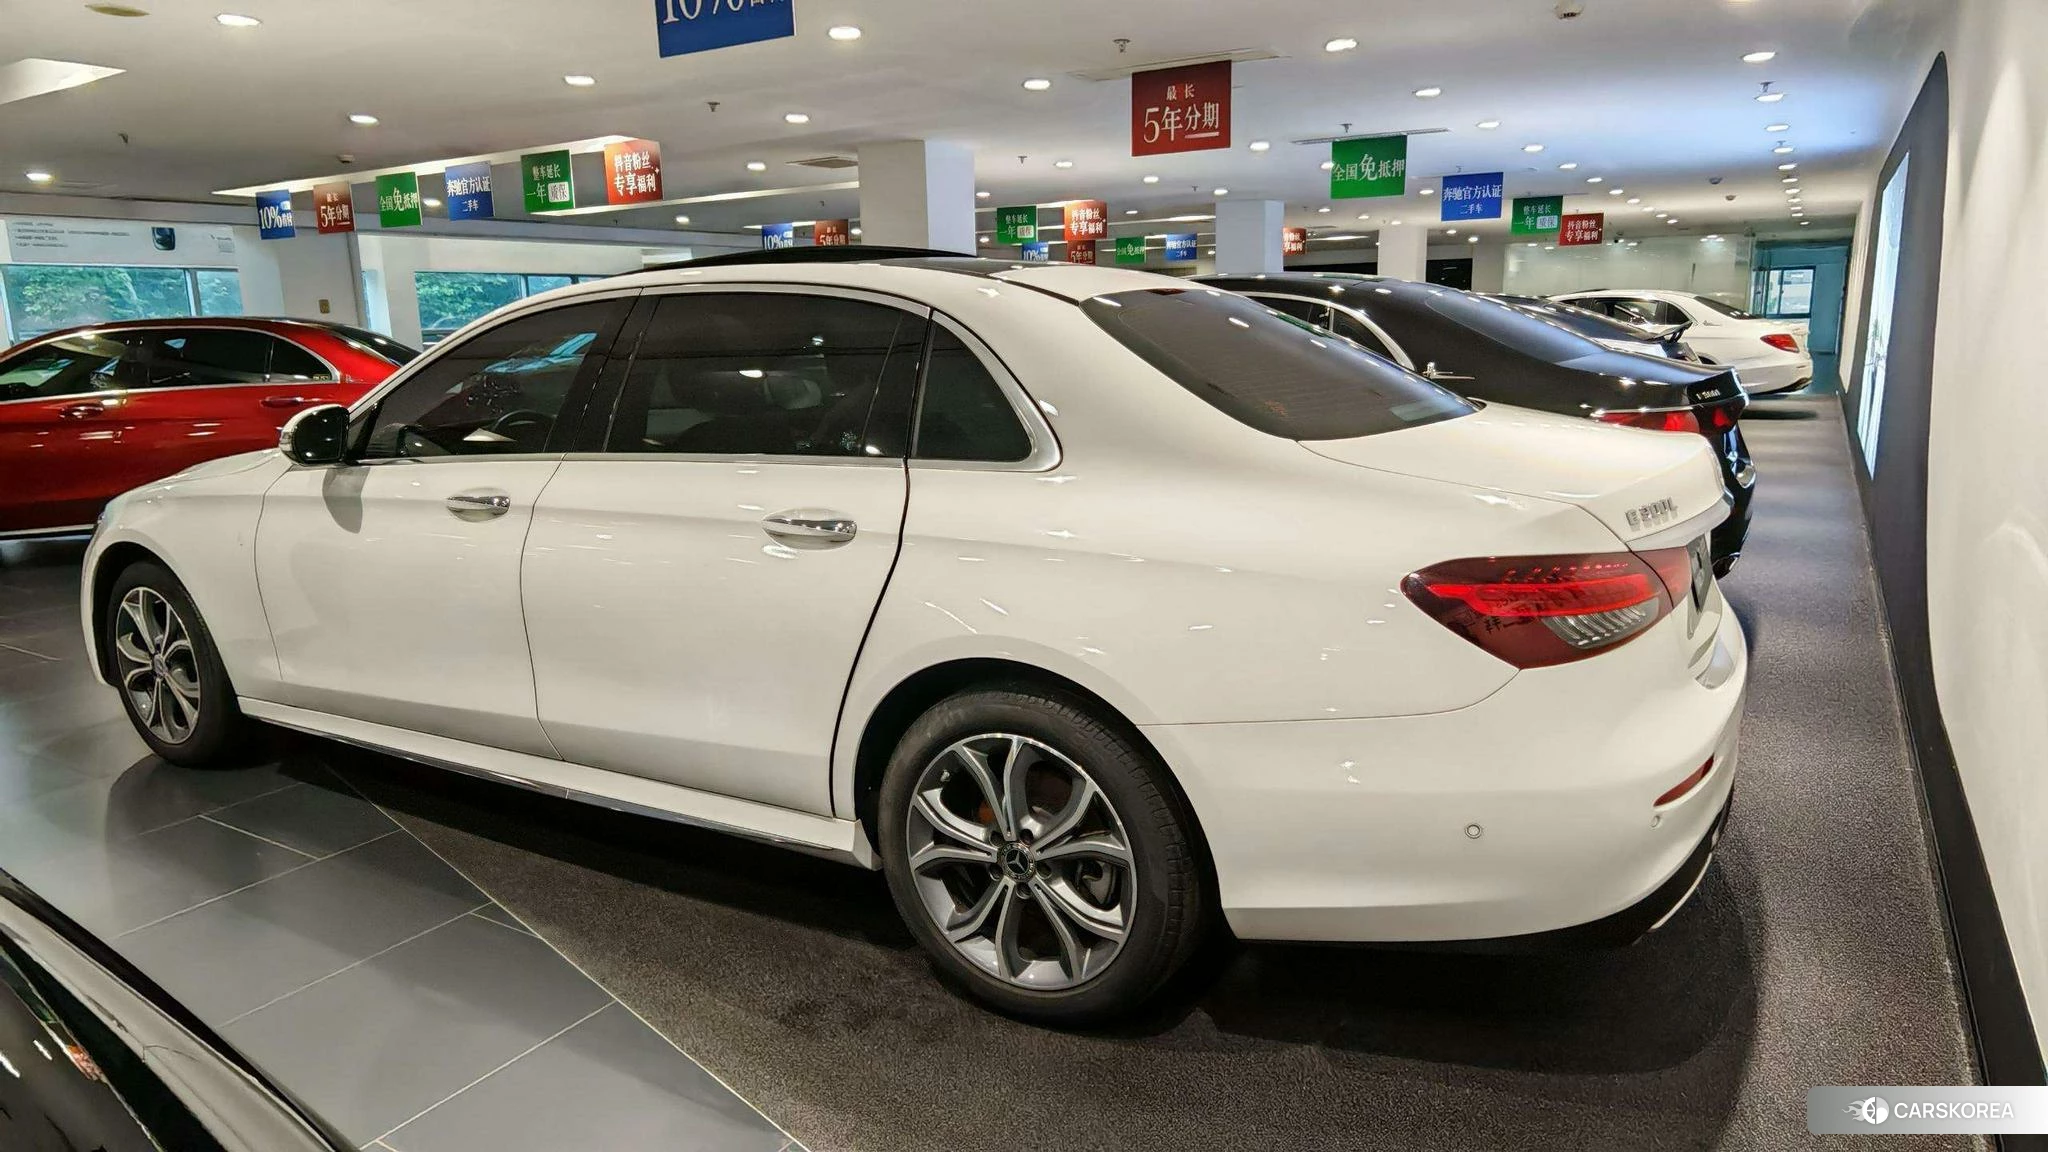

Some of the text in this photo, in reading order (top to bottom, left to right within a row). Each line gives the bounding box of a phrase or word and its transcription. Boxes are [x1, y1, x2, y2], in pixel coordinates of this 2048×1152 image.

[1143, 102, 1220, 143] 5年分期
[1333, 153, 1405, 181] 全国免抵押
[613, 172, 656, 197] 专享福利
[1443, 184, 1502, 201] 奔驰官方认证
[1460, 203, 1483, 215] 二手车
